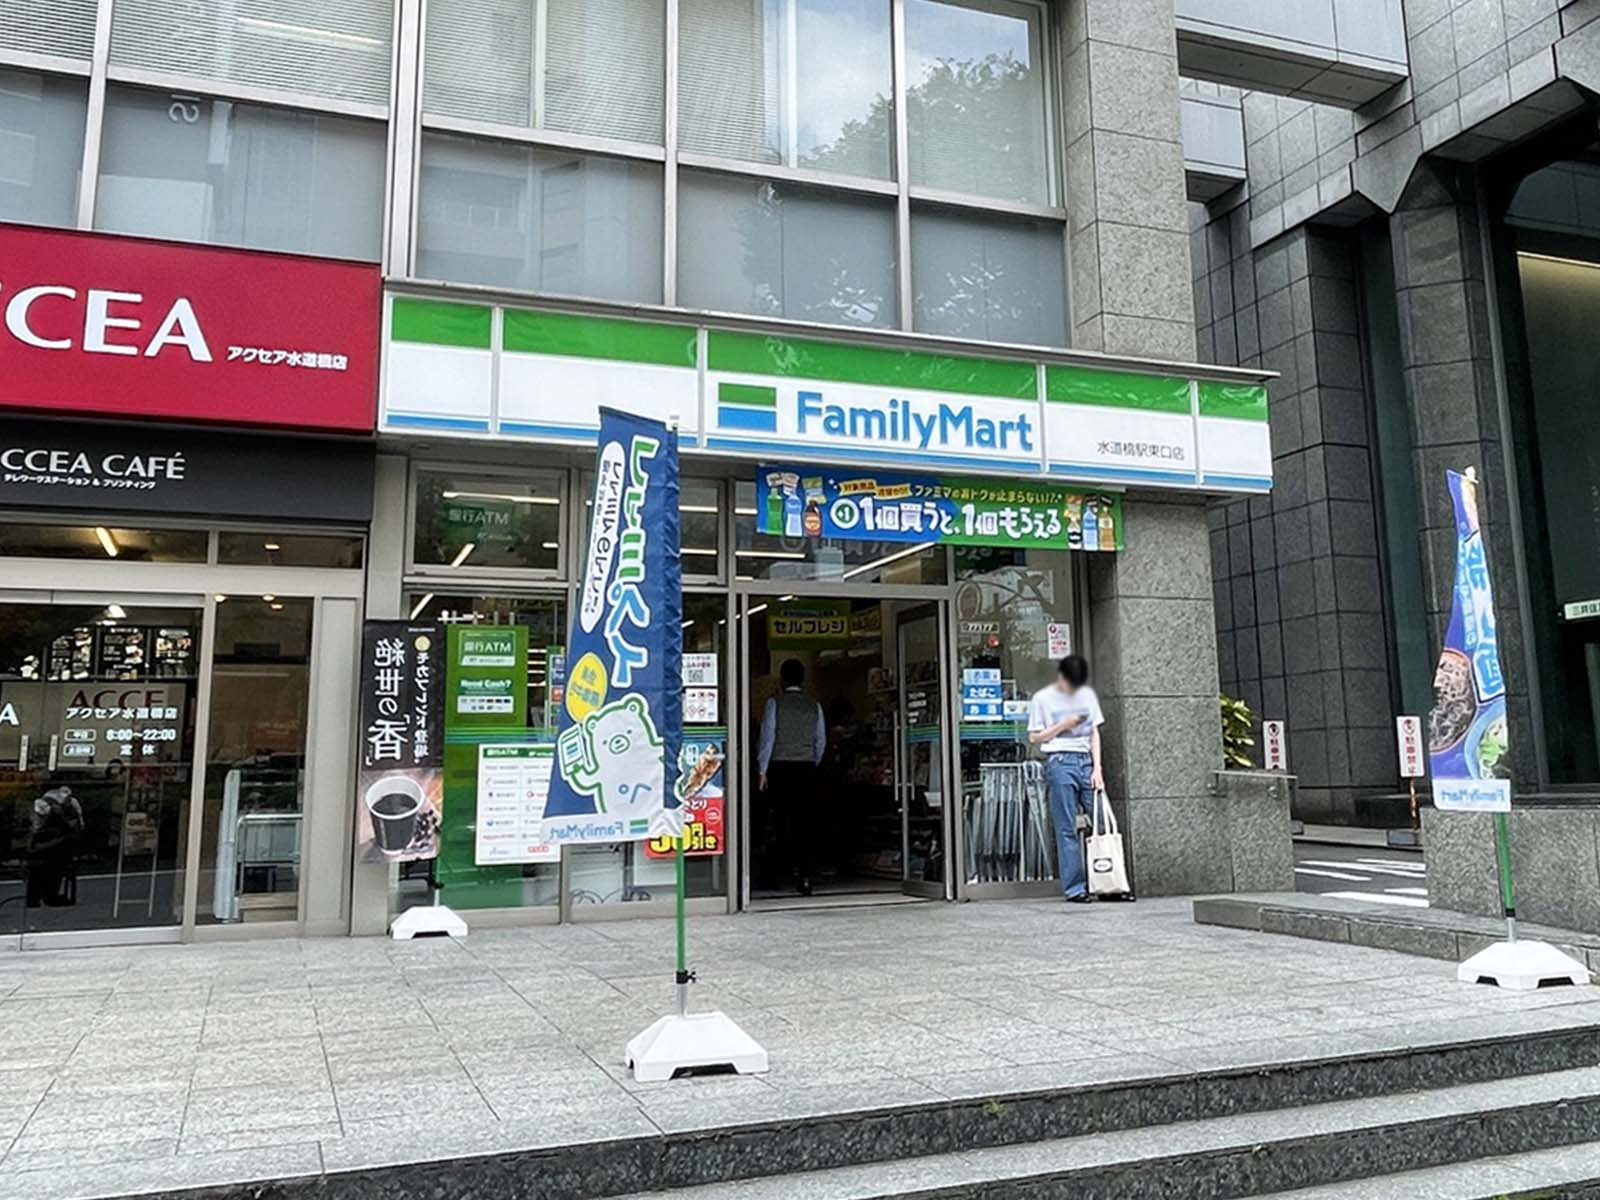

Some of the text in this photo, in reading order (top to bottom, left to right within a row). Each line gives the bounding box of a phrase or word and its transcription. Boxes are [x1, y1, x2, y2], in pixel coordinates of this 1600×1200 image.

[0, 282, 213, 363] CEA
[227, 346, 348, 370] アクセア水道橋店
[797, 390, 1033, 451] FamilyMart
[102, 452, 186, 480] CAFÉ
[774, 620, 845, 634] セルフレジ
